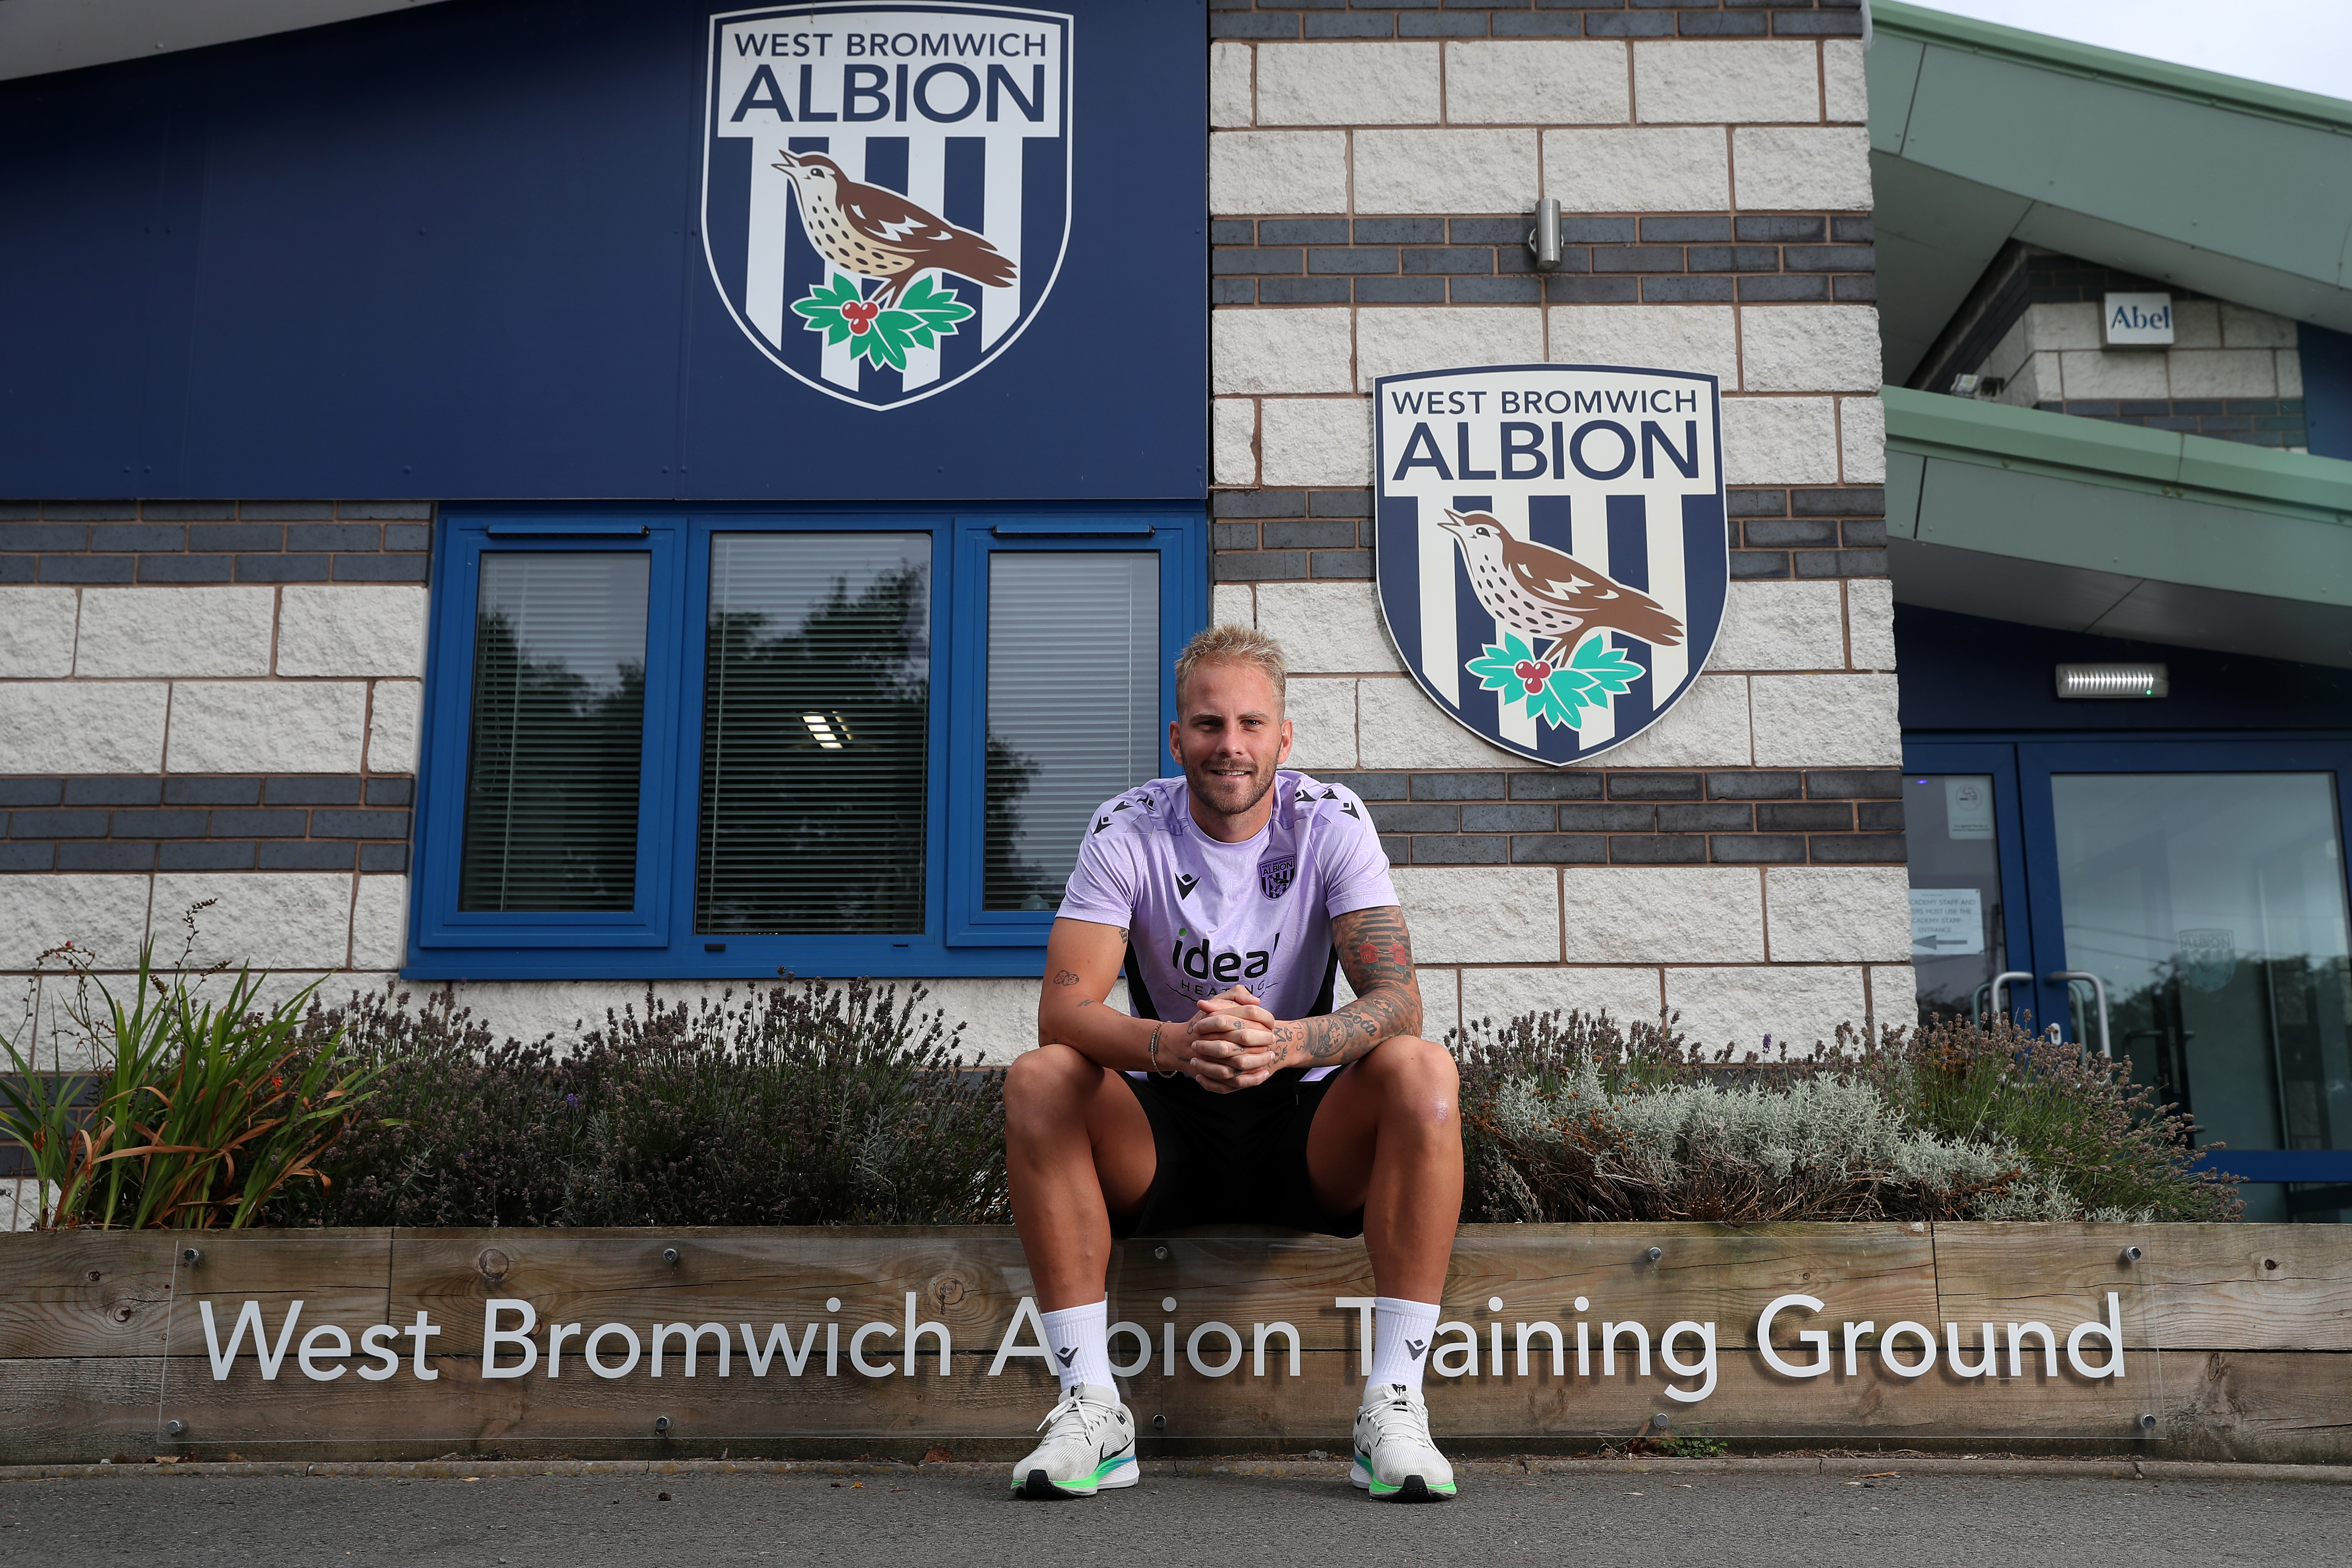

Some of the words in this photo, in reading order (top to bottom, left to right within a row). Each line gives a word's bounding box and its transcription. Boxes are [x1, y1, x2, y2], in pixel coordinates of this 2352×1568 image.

[735, 33, 833, 57] WEST
[847, 33, 1046, 57] BROMWICH
[730, 62, 1045, 123] ALBION
[2112, 305, 2170, 329] Abel
[1391, 391, 1487, 414] WEST
[1501, 389, 1696, 413] BROMWICH
[1392, 420, 1699, 481] ALBION
[1263, 861, 1293, 876] ALBION
[1181, 979, 1265, 997] HEATNG
[199, 1300, 441, 1381] West
[482, 1291, 951, 1379] Bromwich
[987, 1291, 1301, 1377] Abion
[1335, 1296, 1717, 1403] Taining
[1757, 1292, 2125, 1378] Ground
